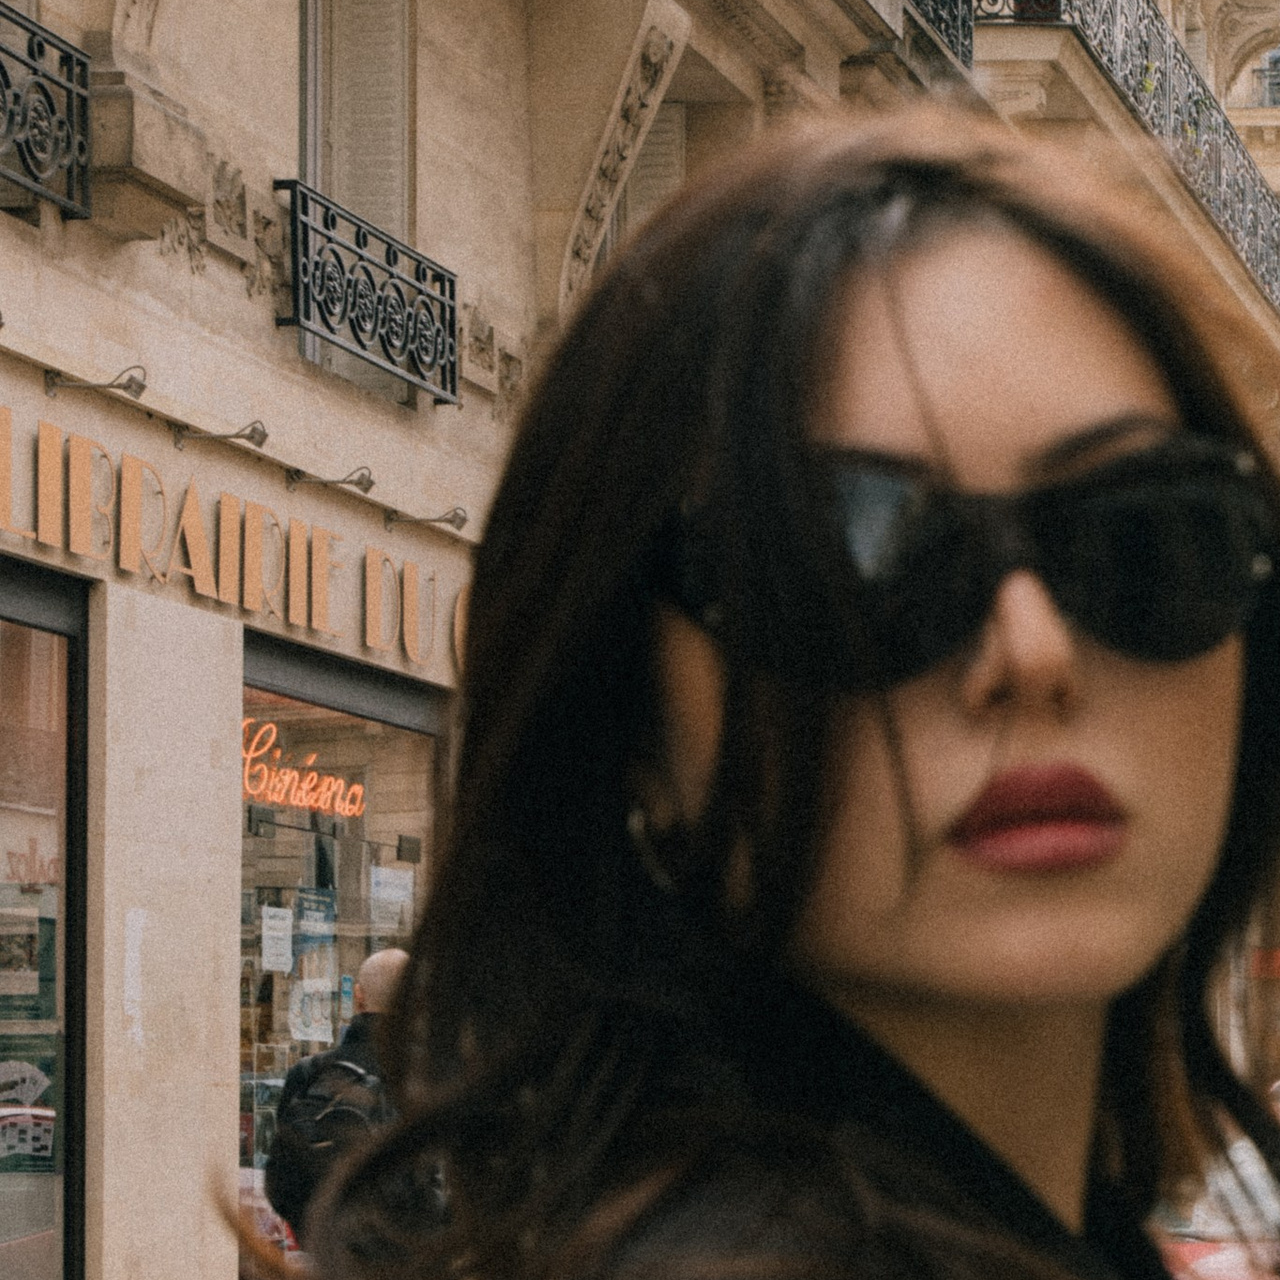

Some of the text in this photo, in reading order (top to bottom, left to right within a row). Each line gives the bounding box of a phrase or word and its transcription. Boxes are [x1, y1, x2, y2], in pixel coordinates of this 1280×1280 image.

[0, 405, 345, 638] LIBRAIRIE
[366, 545, 436, 665] DU
[242, 717, 366, 817] Cinéma
